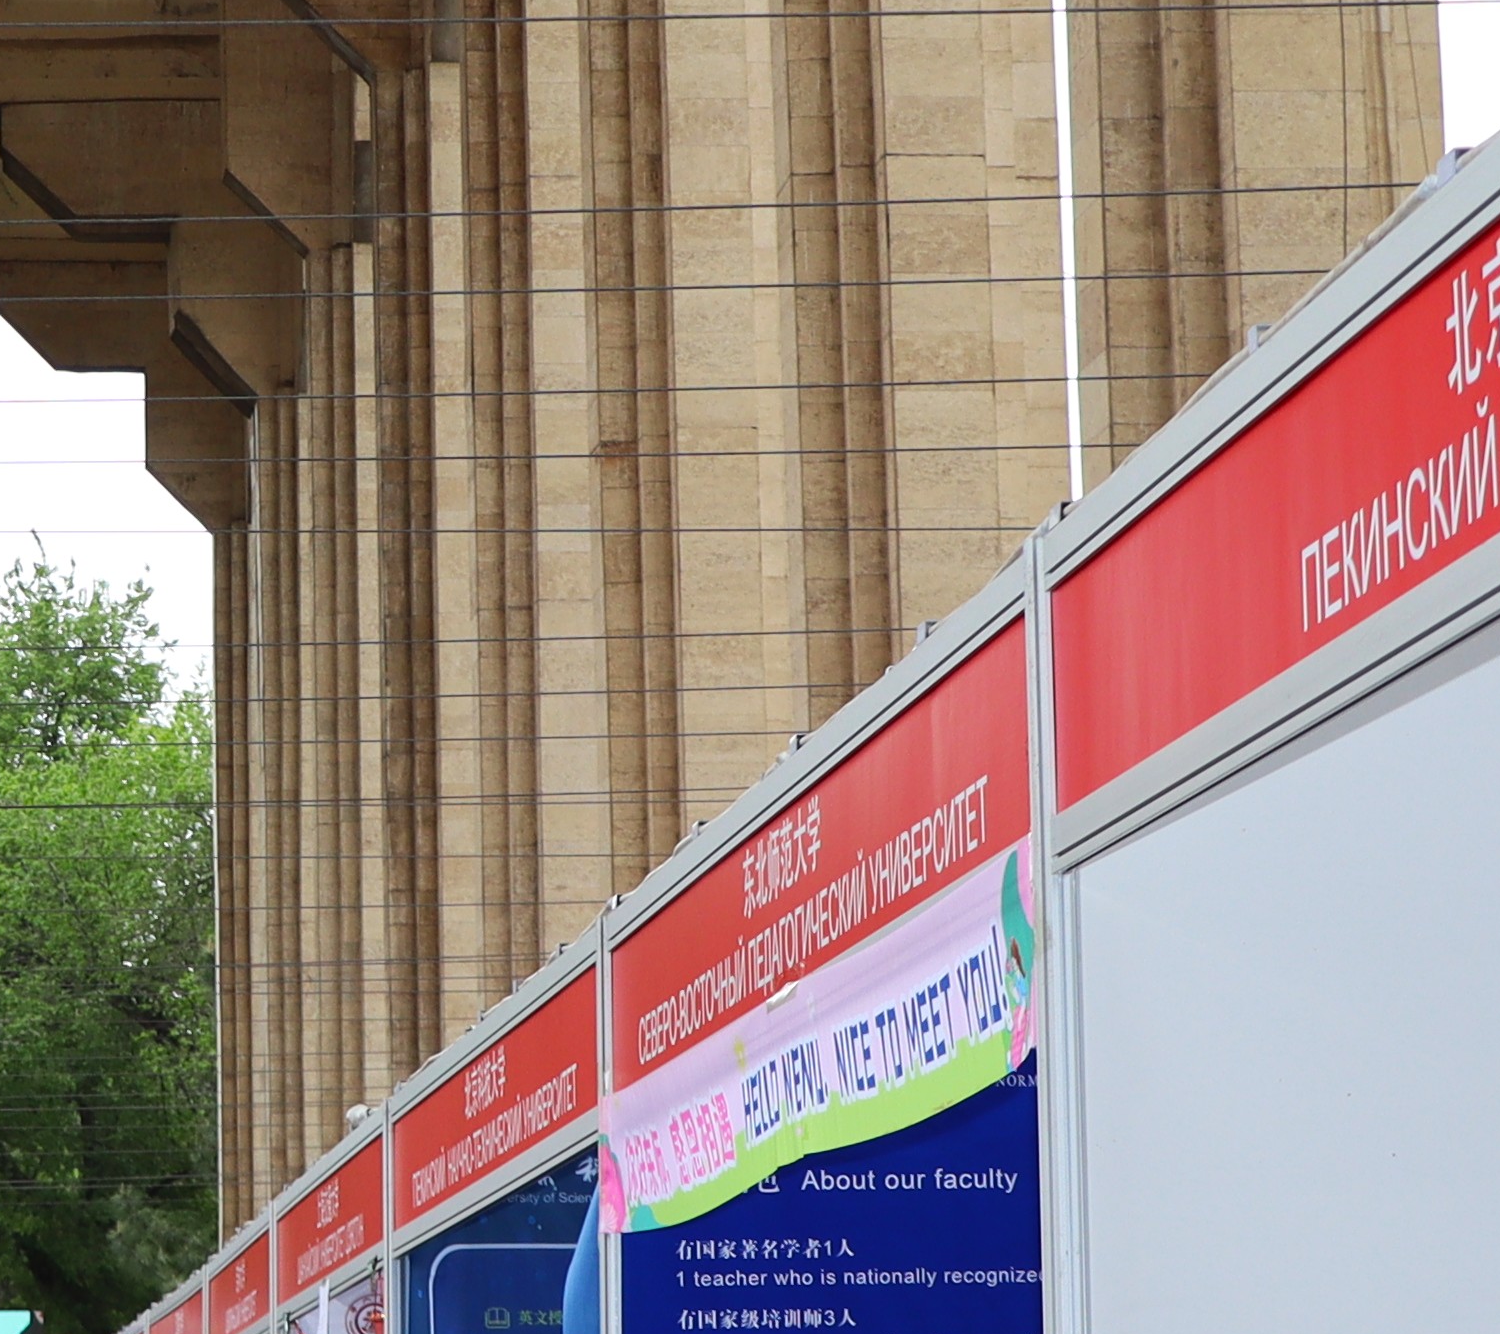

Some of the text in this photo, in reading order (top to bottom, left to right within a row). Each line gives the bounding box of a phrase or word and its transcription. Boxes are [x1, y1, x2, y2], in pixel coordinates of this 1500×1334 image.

[1300, 395, 1499, 632] ПЕКИНСКИЙ
[741, 793, 822, 920] 东北师范大学
[637, 774, 988, 1066] СЕВЕРО-ВОСТОЧНЫЙ ПЕДАГОГИЧЕСКИЙ УНИВЕРСИТЕТ
[741, 1059, 781, 1145] HELLO
[833, 1020, 876, 1099] NICE
[875, 1006, 904, 1084] TO
[902, 972, 955, 1071] MEET
[956, 924, 1009, 1039] YOU!
[801, 1169, 876, 1191] About
[884, 1172, 927, 1190] our
[934, 1167, 1018, 1194] faculty
[676, 1238, 855, 1261] 有国家著名学者1人
[676, 1271, 685, 1287] 1
[694, 1269, 767, 1287] teacher
[774, 1269, 814, 1286] who
[820, 1269, 837, 1286] is
[844, 1267, 937, 1289] nationally
[677, 1308, 857, 1331] 有国家级培训师3人
